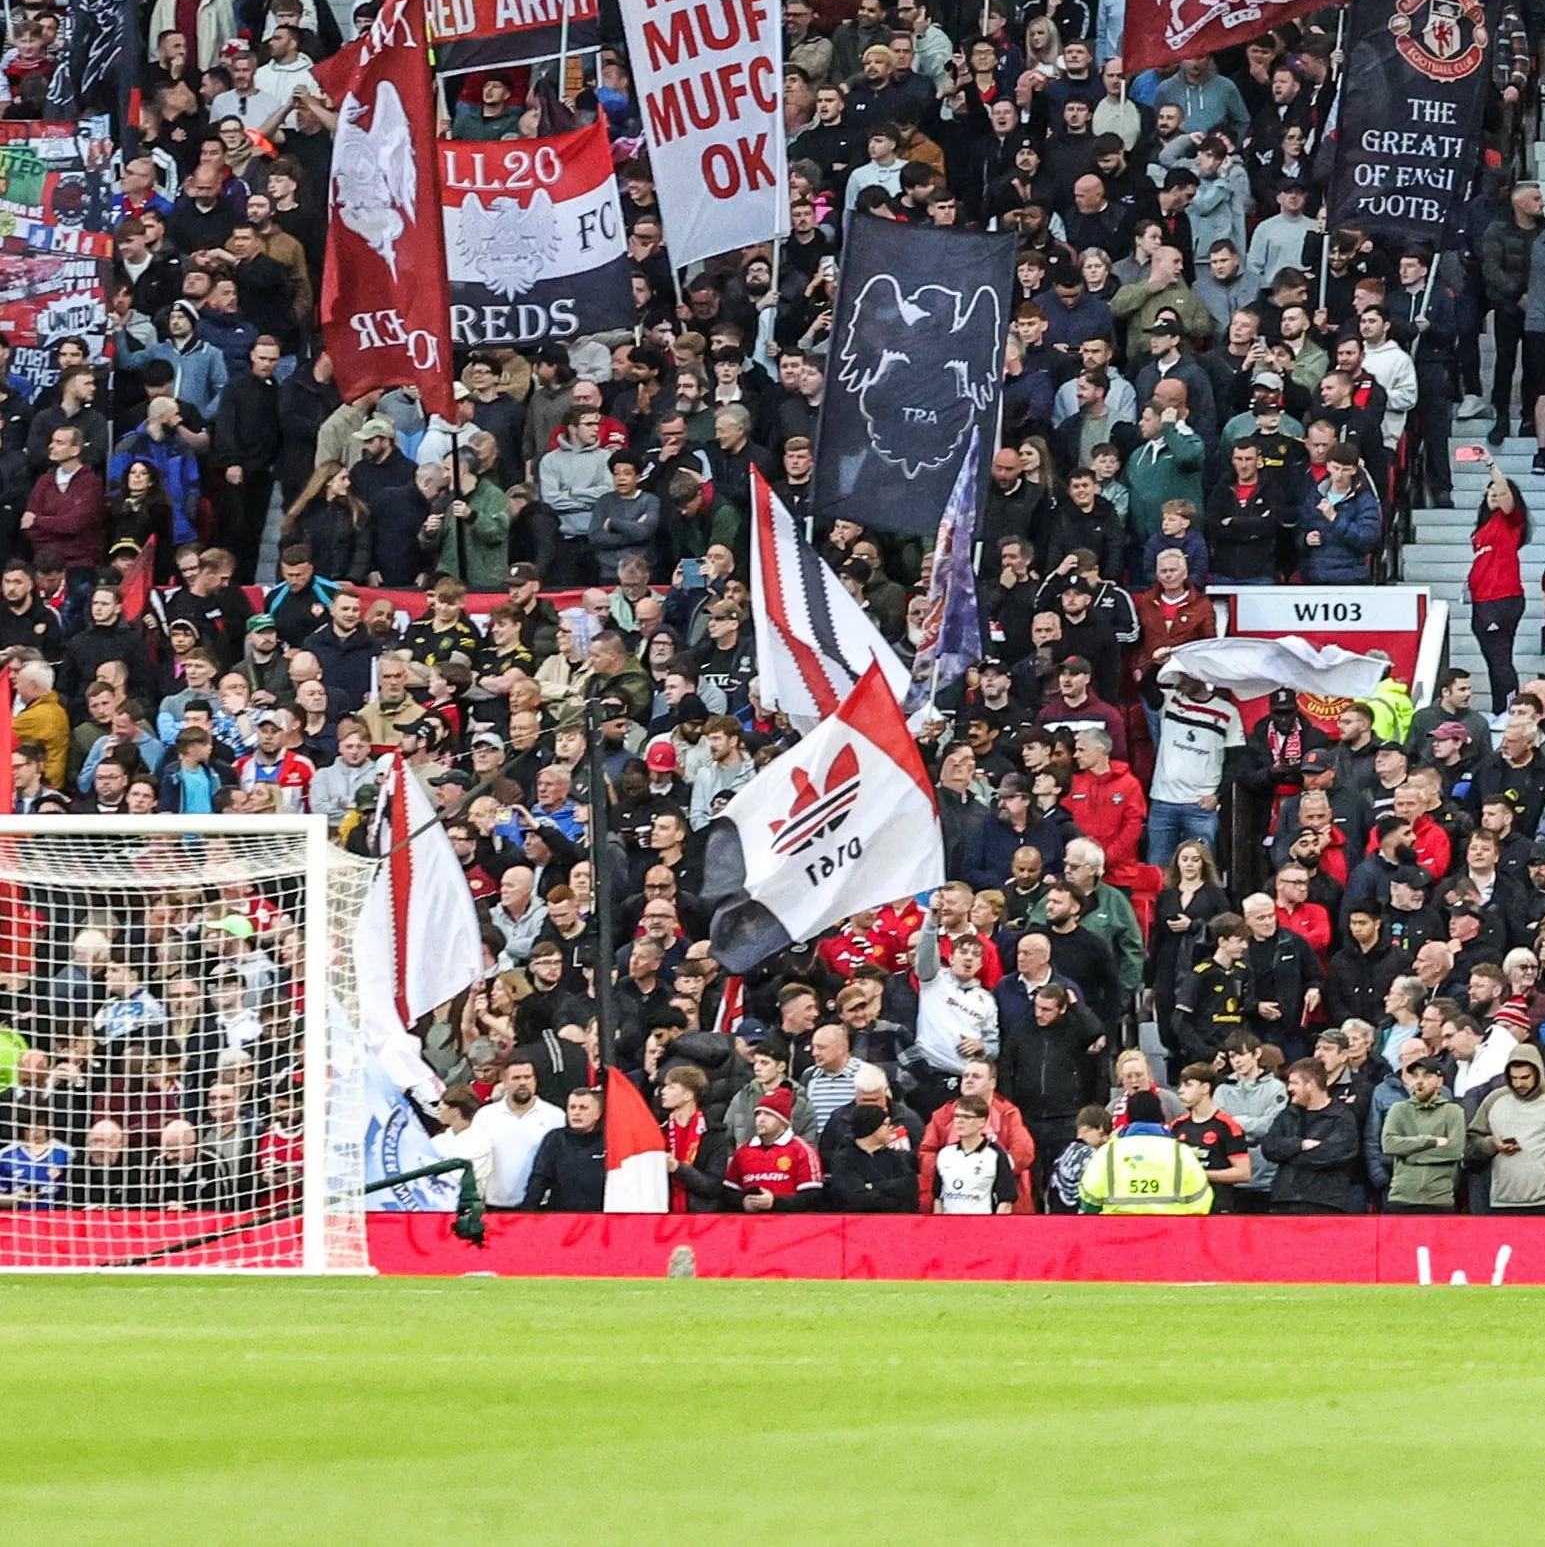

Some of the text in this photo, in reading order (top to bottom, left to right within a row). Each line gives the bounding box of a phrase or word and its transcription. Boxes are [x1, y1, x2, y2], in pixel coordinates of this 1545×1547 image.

[644, 55, 778, 148] MUFC
[1407, 97, 1457, 126] THE
[701, 133, 777, 201] OK
[1354, 162, 1387, 188] OF
[577, 200, 617, 252] FC
[450, 299, 581, 344] REDS
[902, 407, 938, 427] TRA
[1293, 602, 1363, 623] W103
[1129, 1179, 1160, 1194] 529
